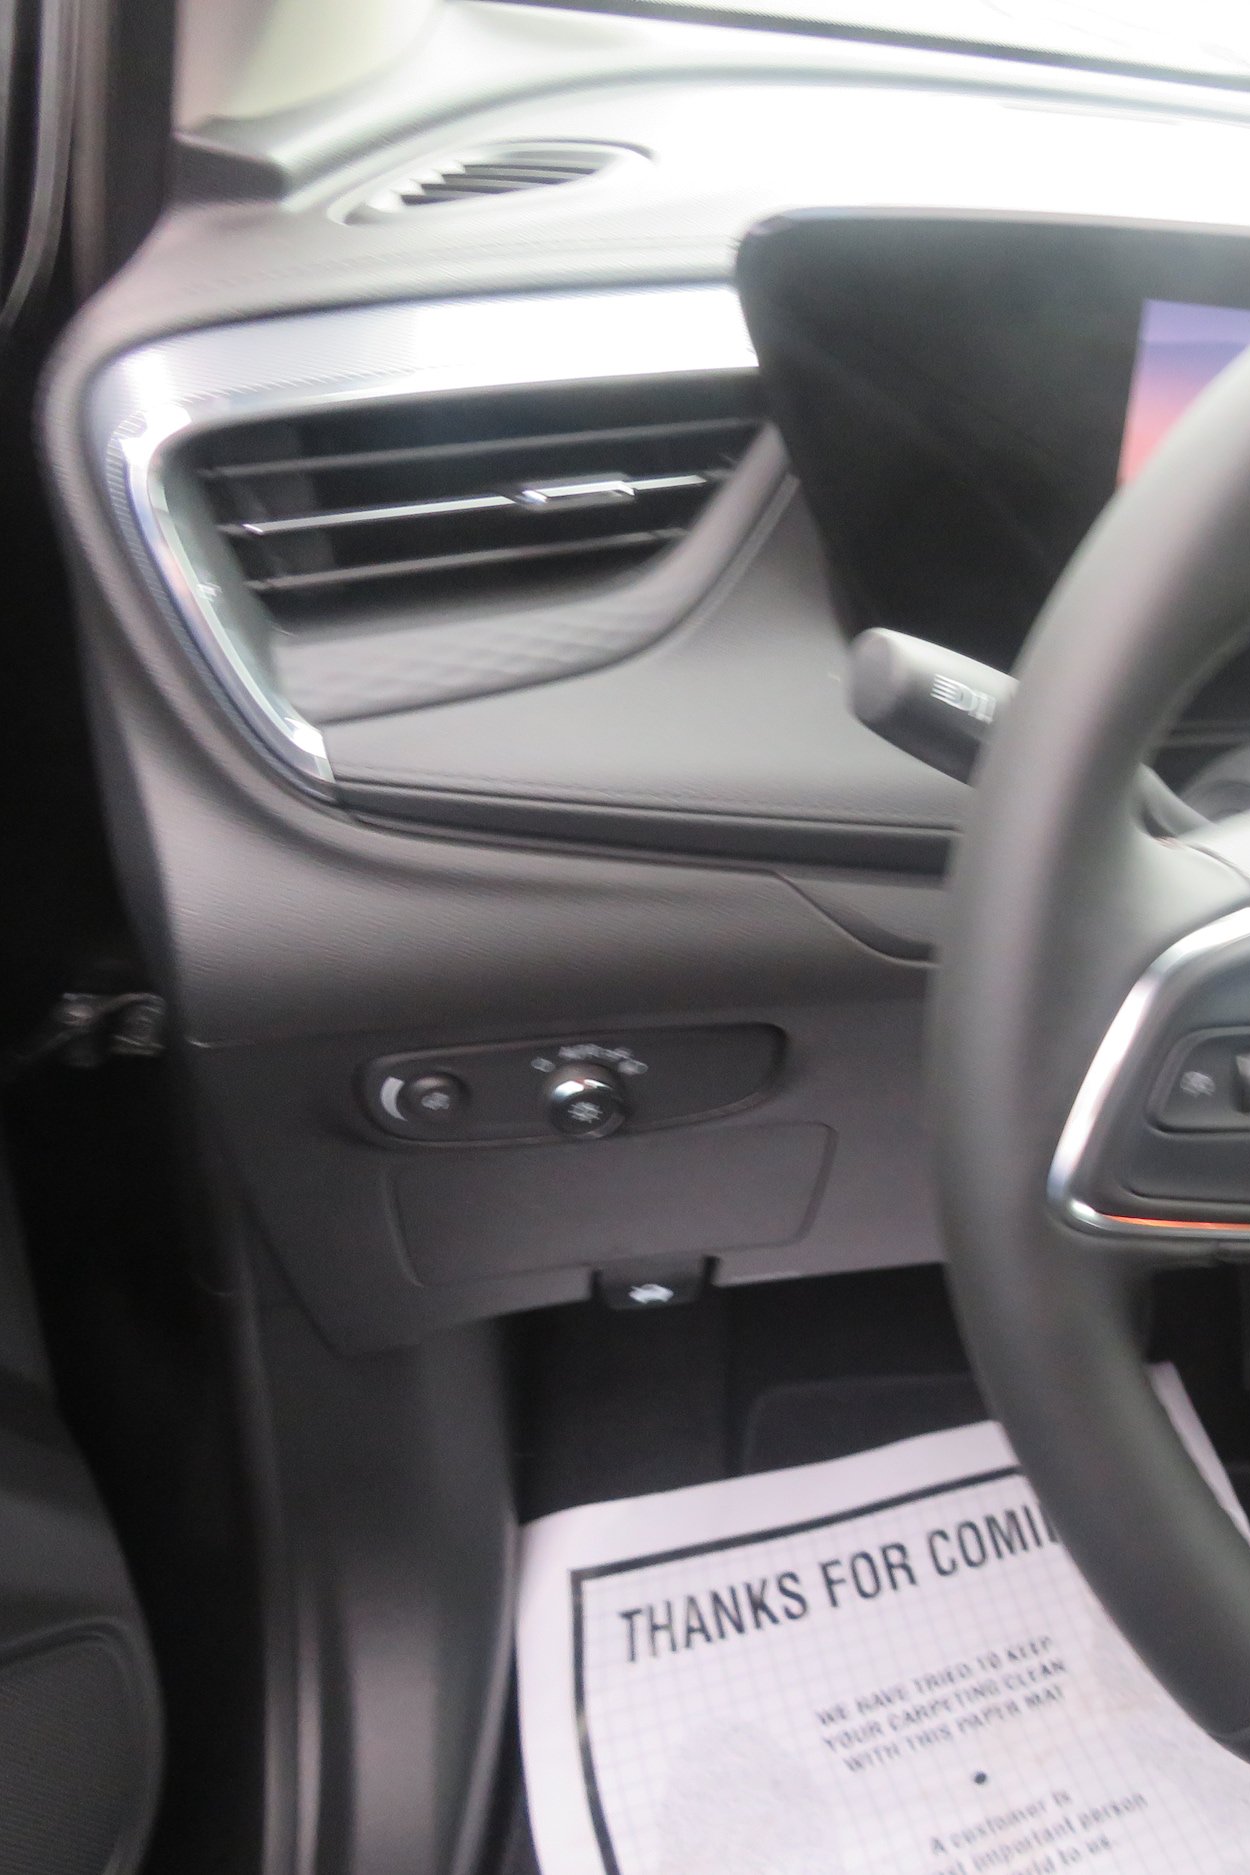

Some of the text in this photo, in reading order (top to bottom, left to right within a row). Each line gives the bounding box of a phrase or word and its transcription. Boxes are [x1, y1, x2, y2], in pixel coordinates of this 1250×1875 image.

[618, 1570, 810, 1664] THANKS
[817, 1541, 918, 1609] FOR
[815, 1702, 848, 1727] WE
[976, 1649, 1002, 1672] TO
[822, 1719, 885, 1751] YOUR
[842, 1741, 901, 1773] WITH
[904, 1722, 955, 1753] THIS
